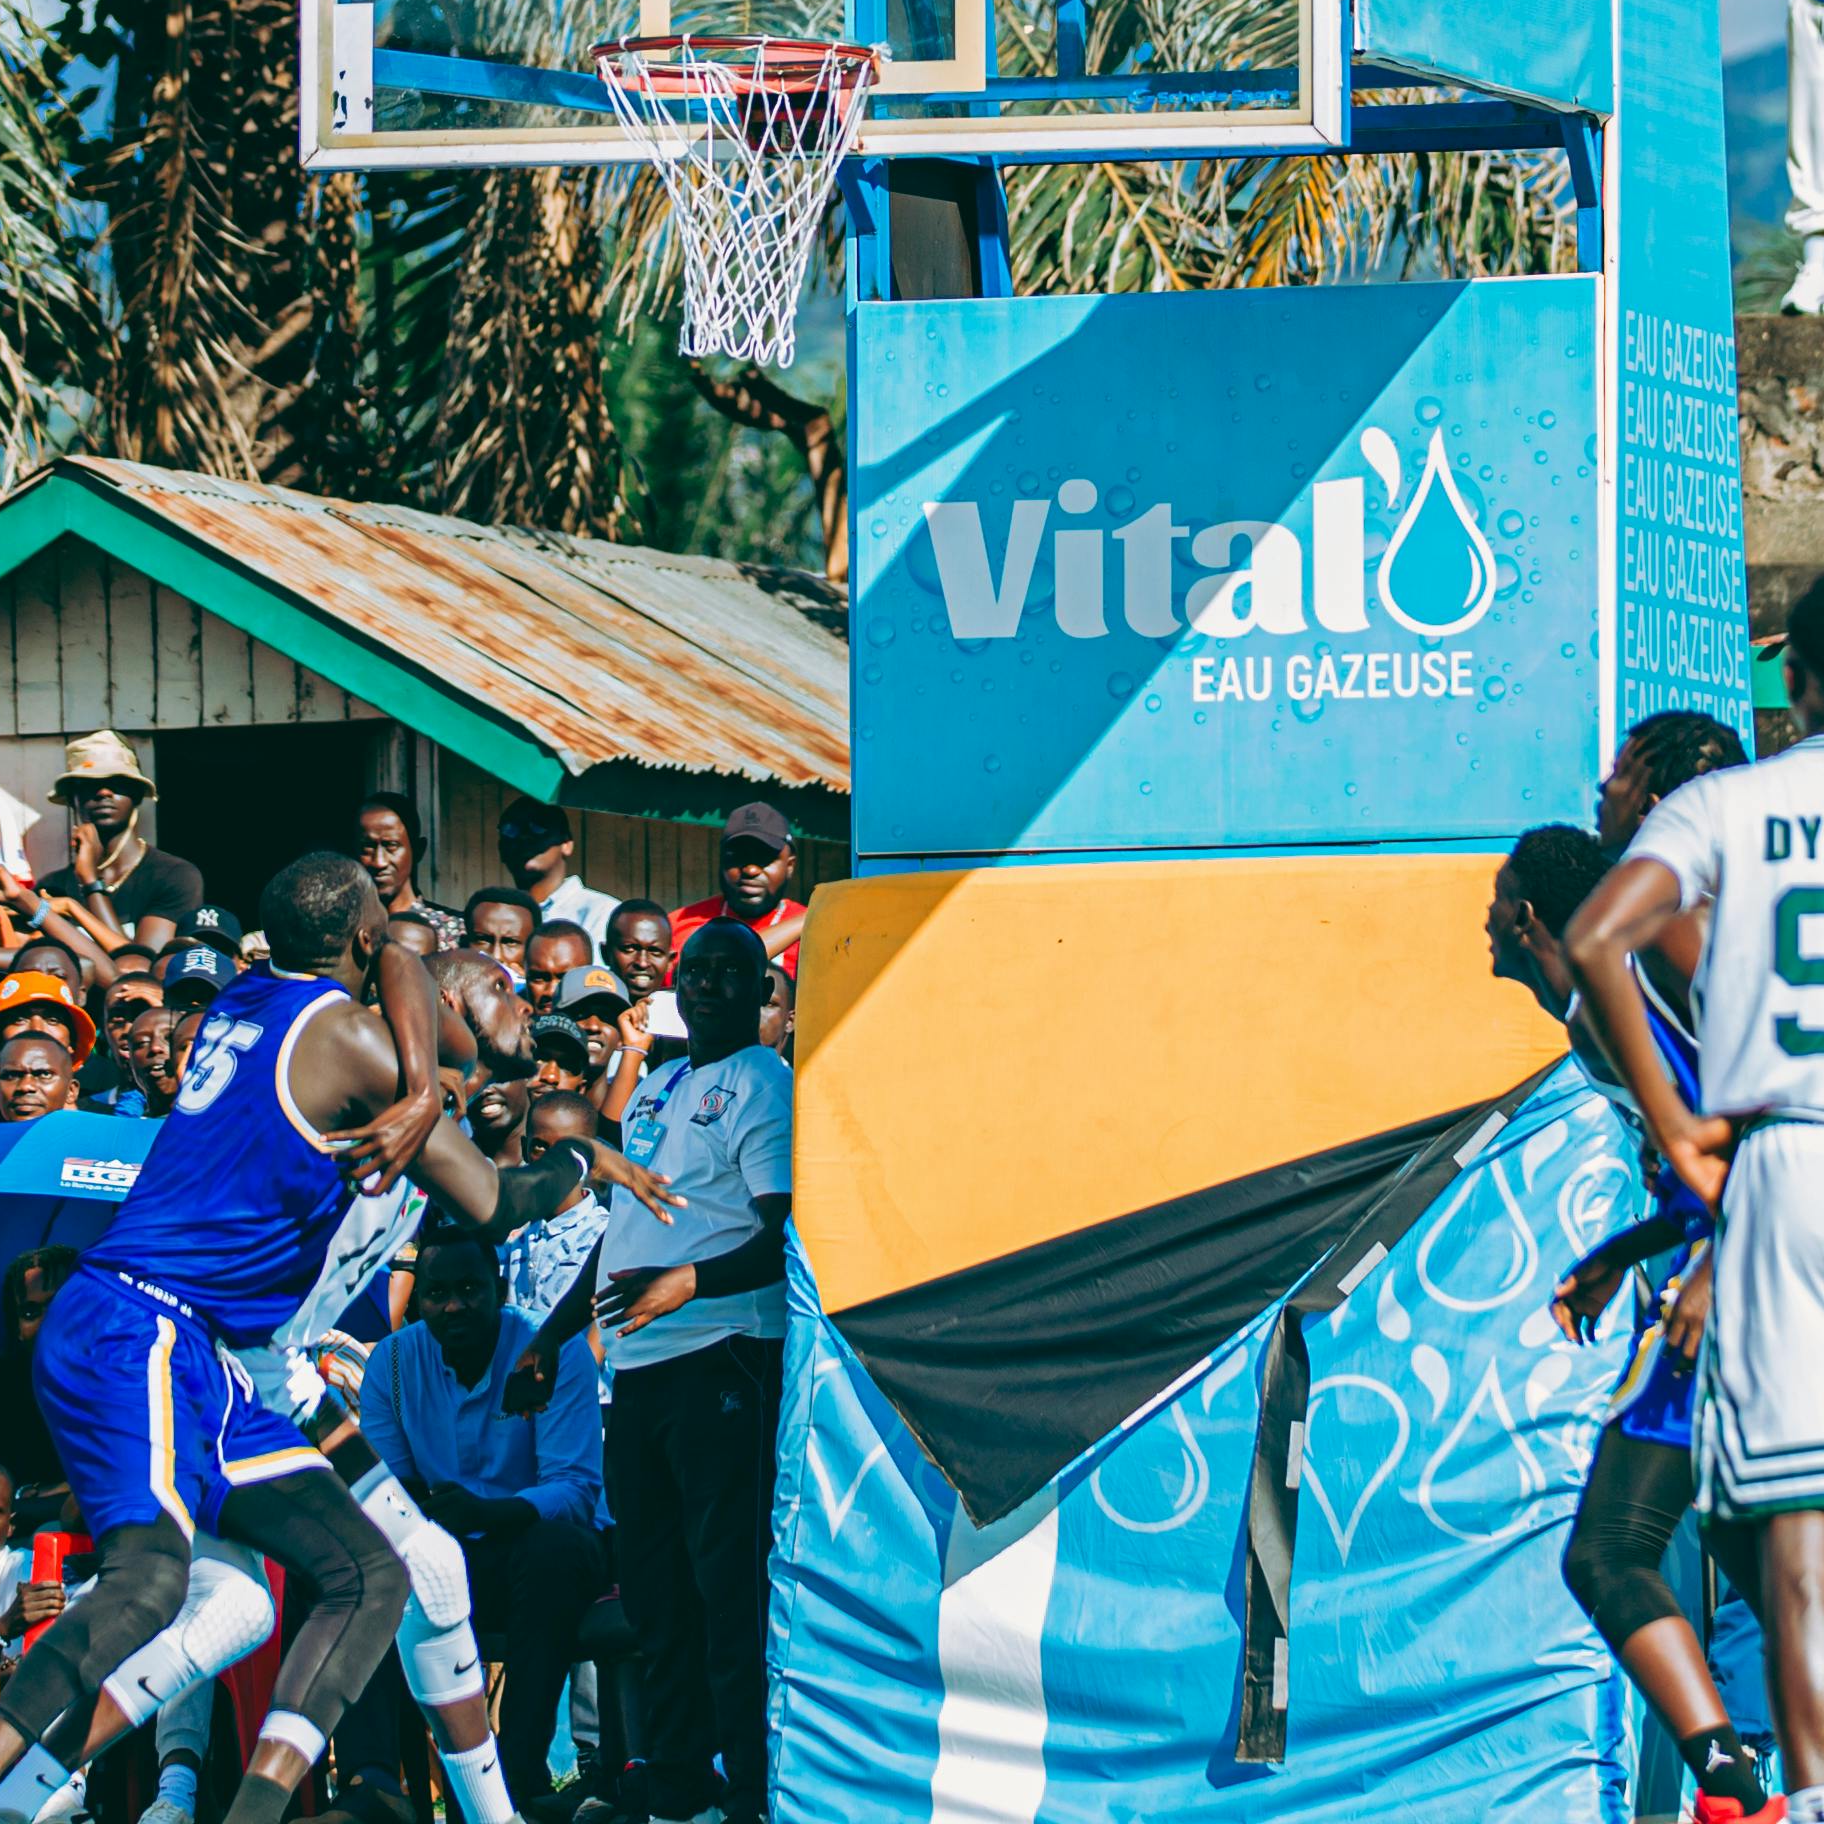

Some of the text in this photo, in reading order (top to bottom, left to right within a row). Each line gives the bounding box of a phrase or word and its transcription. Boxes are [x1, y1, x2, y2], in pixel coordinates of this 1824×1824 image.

[1625, 310, 1736, 397] EAU GAZEUSE
[1625, 382, 1737, 468] EAU GAZEUSE
[1625, 454, 1738, 539] EAU GAZEUSE
[1625, 526, 1742, 614] EAU GAZEUSE
[1192, 651, 1475, 703] EAU GAZEUSE
[1625, 601, 1745, 690] EAU GAZEUSE
